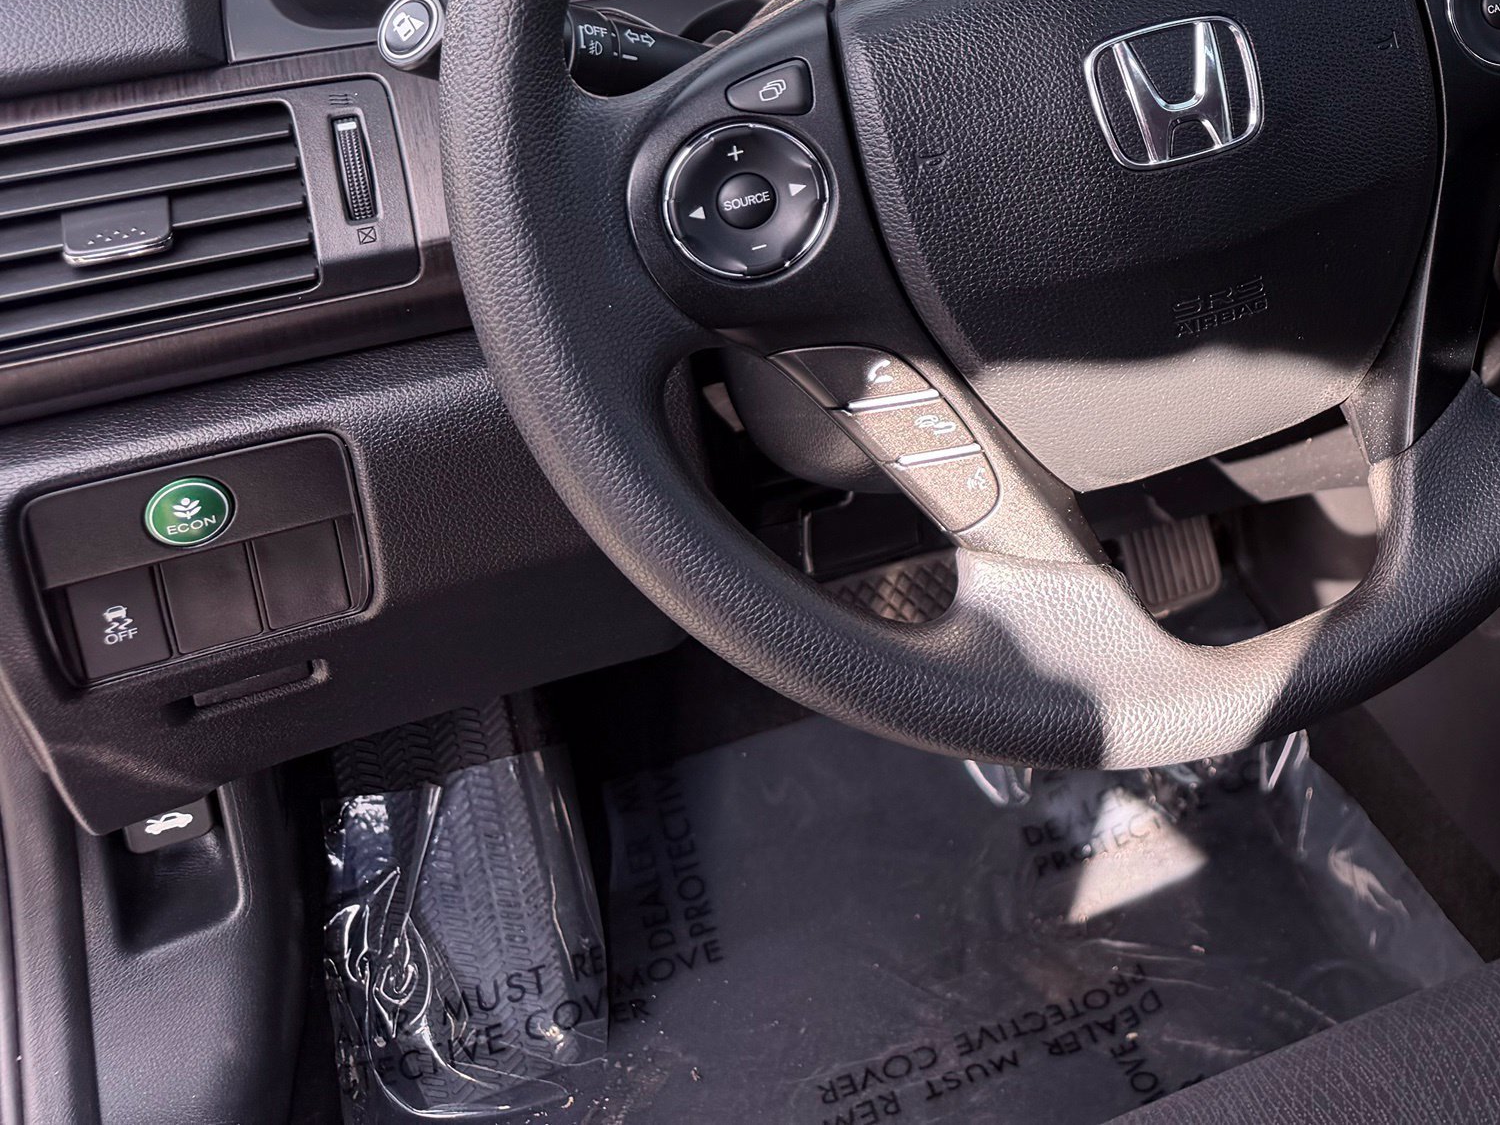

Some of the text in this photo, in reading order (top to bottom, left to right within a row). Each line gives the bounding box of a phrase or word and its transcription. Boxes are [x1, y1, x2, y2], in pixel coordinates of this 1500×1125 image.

[583, 23, 608, 38] OFF
[723, 190, 771, 213] SOURCE
[1172, 276, 1264, 319] SRS
[1176, 298, 1268, 339] AIRBAG
[166, 515, 217, 536] ECON
[103, 627, 138, 646] OFF
[443, 964, 548, 1026] MUST
[815, 961, 1149, 1106] PROTECTIVE COVER
[1042, 987, 1163, 1058] DEALER
[923, 1049, 1021, 1102] MUST
